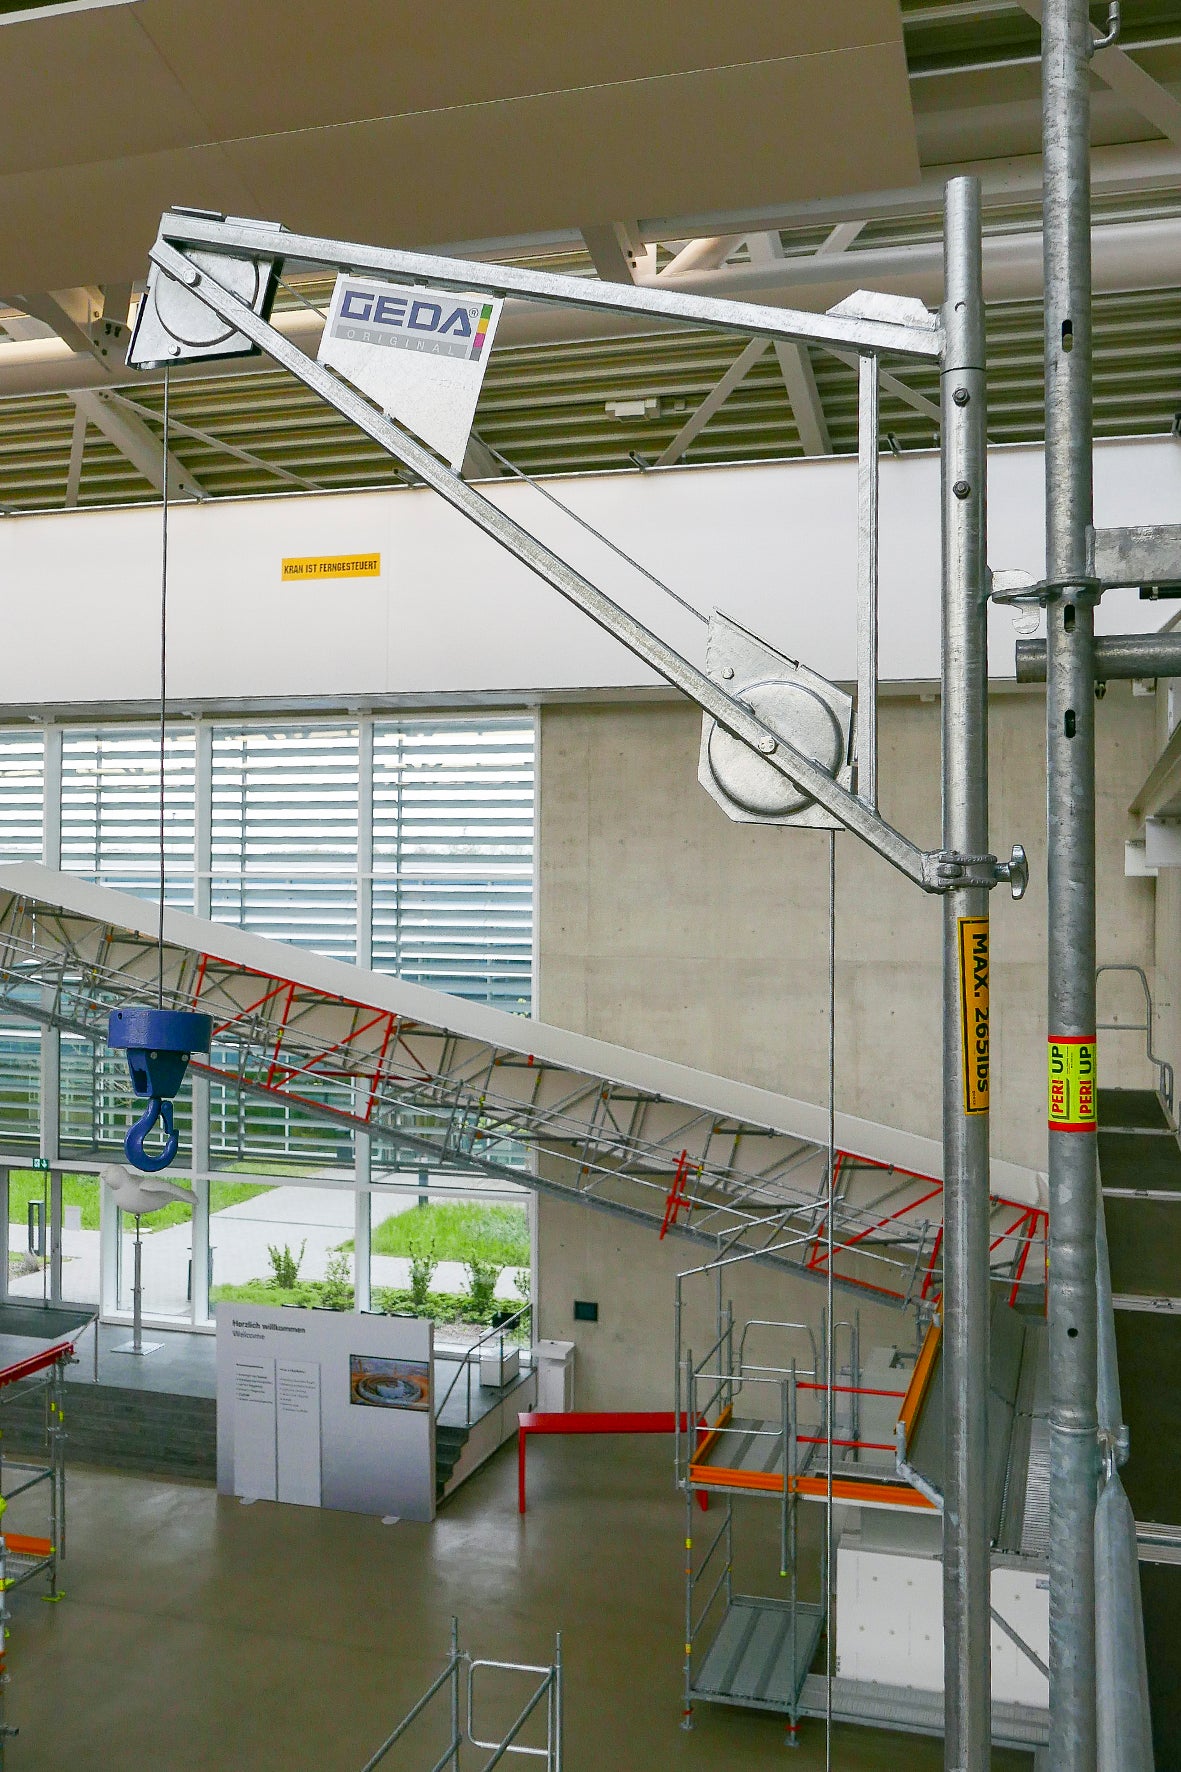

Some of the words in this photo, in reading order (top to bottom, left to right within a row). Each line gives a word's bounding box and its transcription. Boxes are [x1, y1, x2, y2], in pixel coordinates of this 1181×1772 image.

[340, 290, 472, 337] GEDA
[346, 329, 455, 355] ORIGINAL
[284, 565, 303, 574] KRAN
[306, 564, 317, 573] IST
[319, 561, 377, 572] FERNGESTEUERT
[972, 933, 989, 998] MAX.
[974, 1007, 989, 1093] 265lbs
[1051, 1045, 1064, 1074] UP
[1079, 1046, 1092, 1075] UP
[1051, 1079, 1064, 1114] PERI
[1079, 1080, 1092, 1114] PERI
[232, 1319, 261, 1329] Herzlich
[262, 1323, 306, 1333] willkommen
[232, 1330, 265, 1339] Welcome
